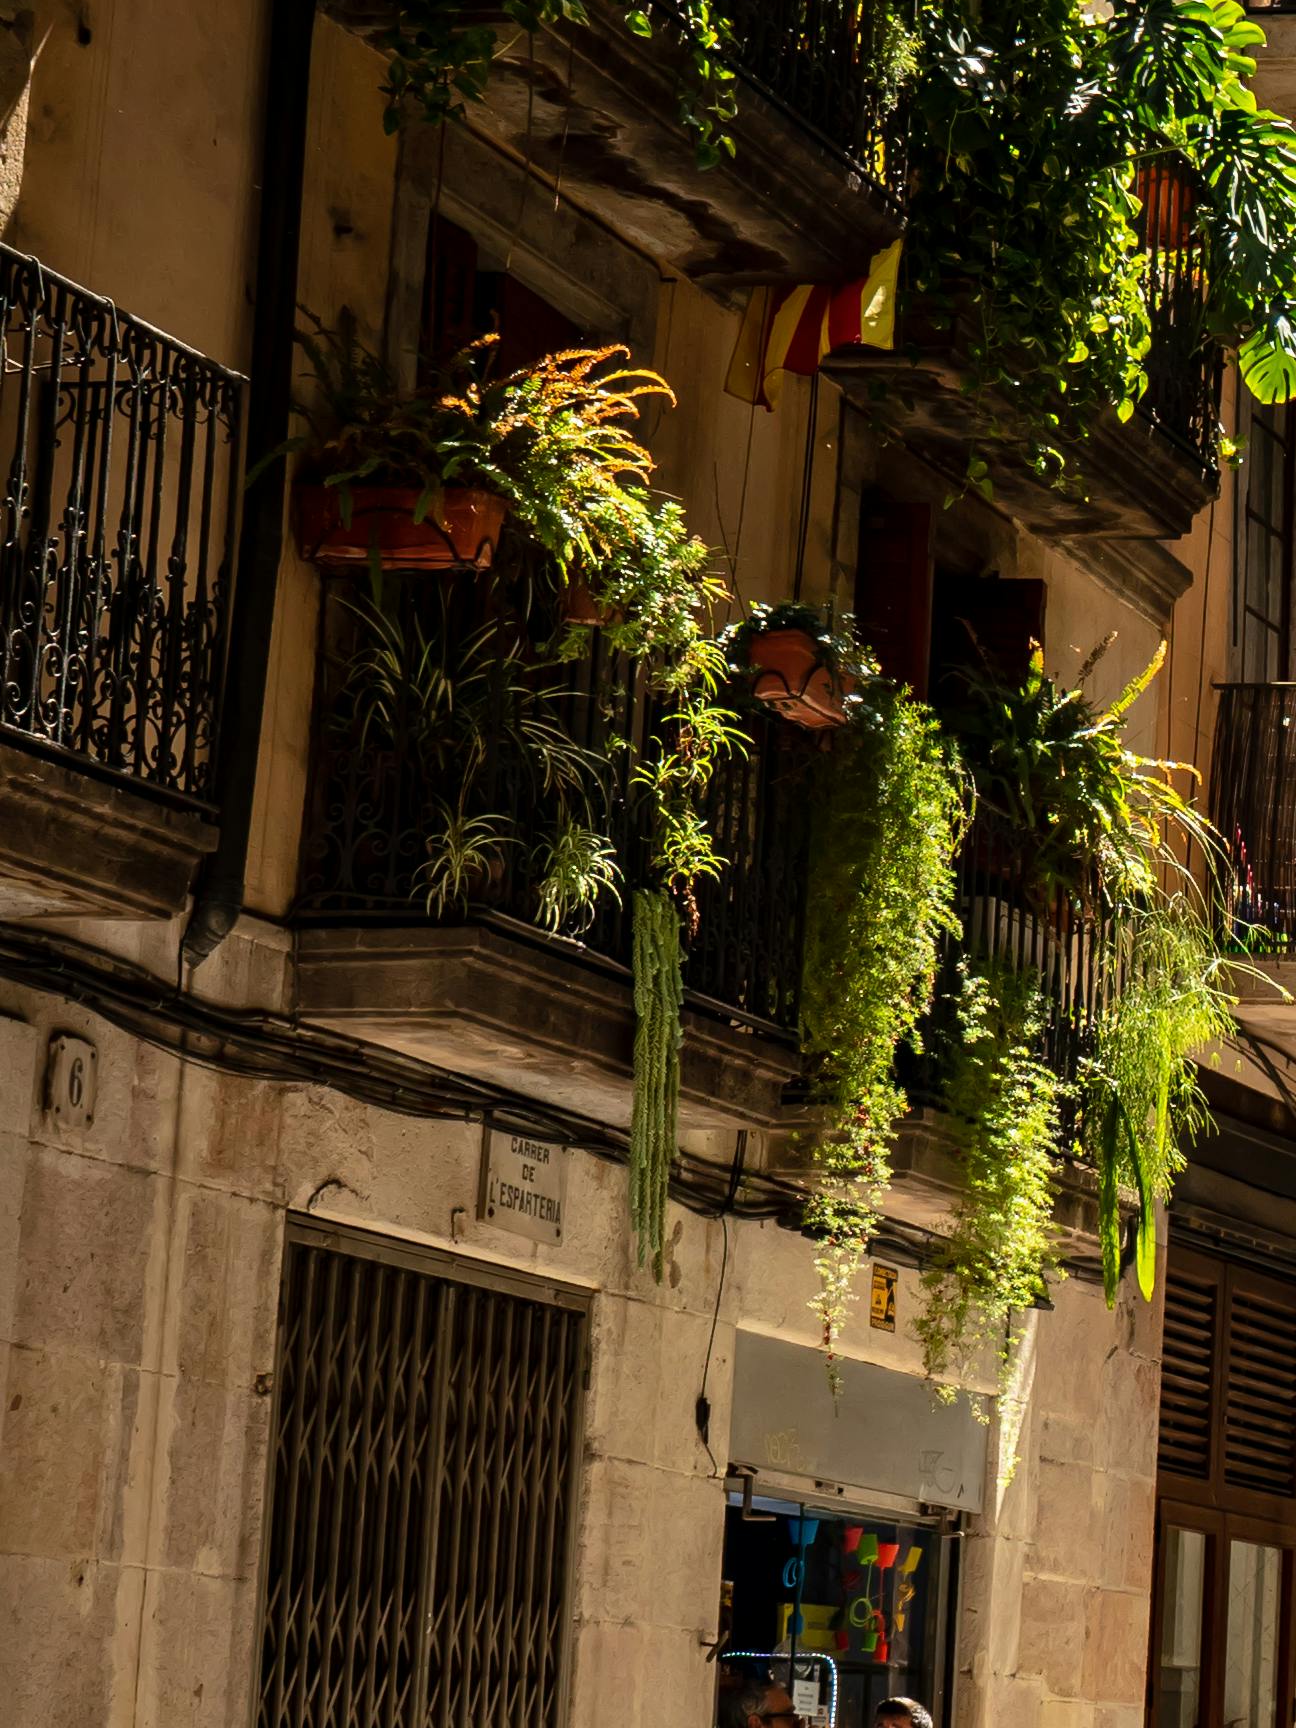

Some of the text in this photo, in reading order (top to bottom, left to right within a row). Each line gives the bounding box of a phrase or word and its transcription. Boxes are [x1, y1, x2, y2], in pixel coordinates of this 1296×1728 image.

[511, 1136, 549, 1164] CARRER
[522, 1164, 535, 1182] DE
[489, 1177, 561, 1225] L'ESPARTERIA
